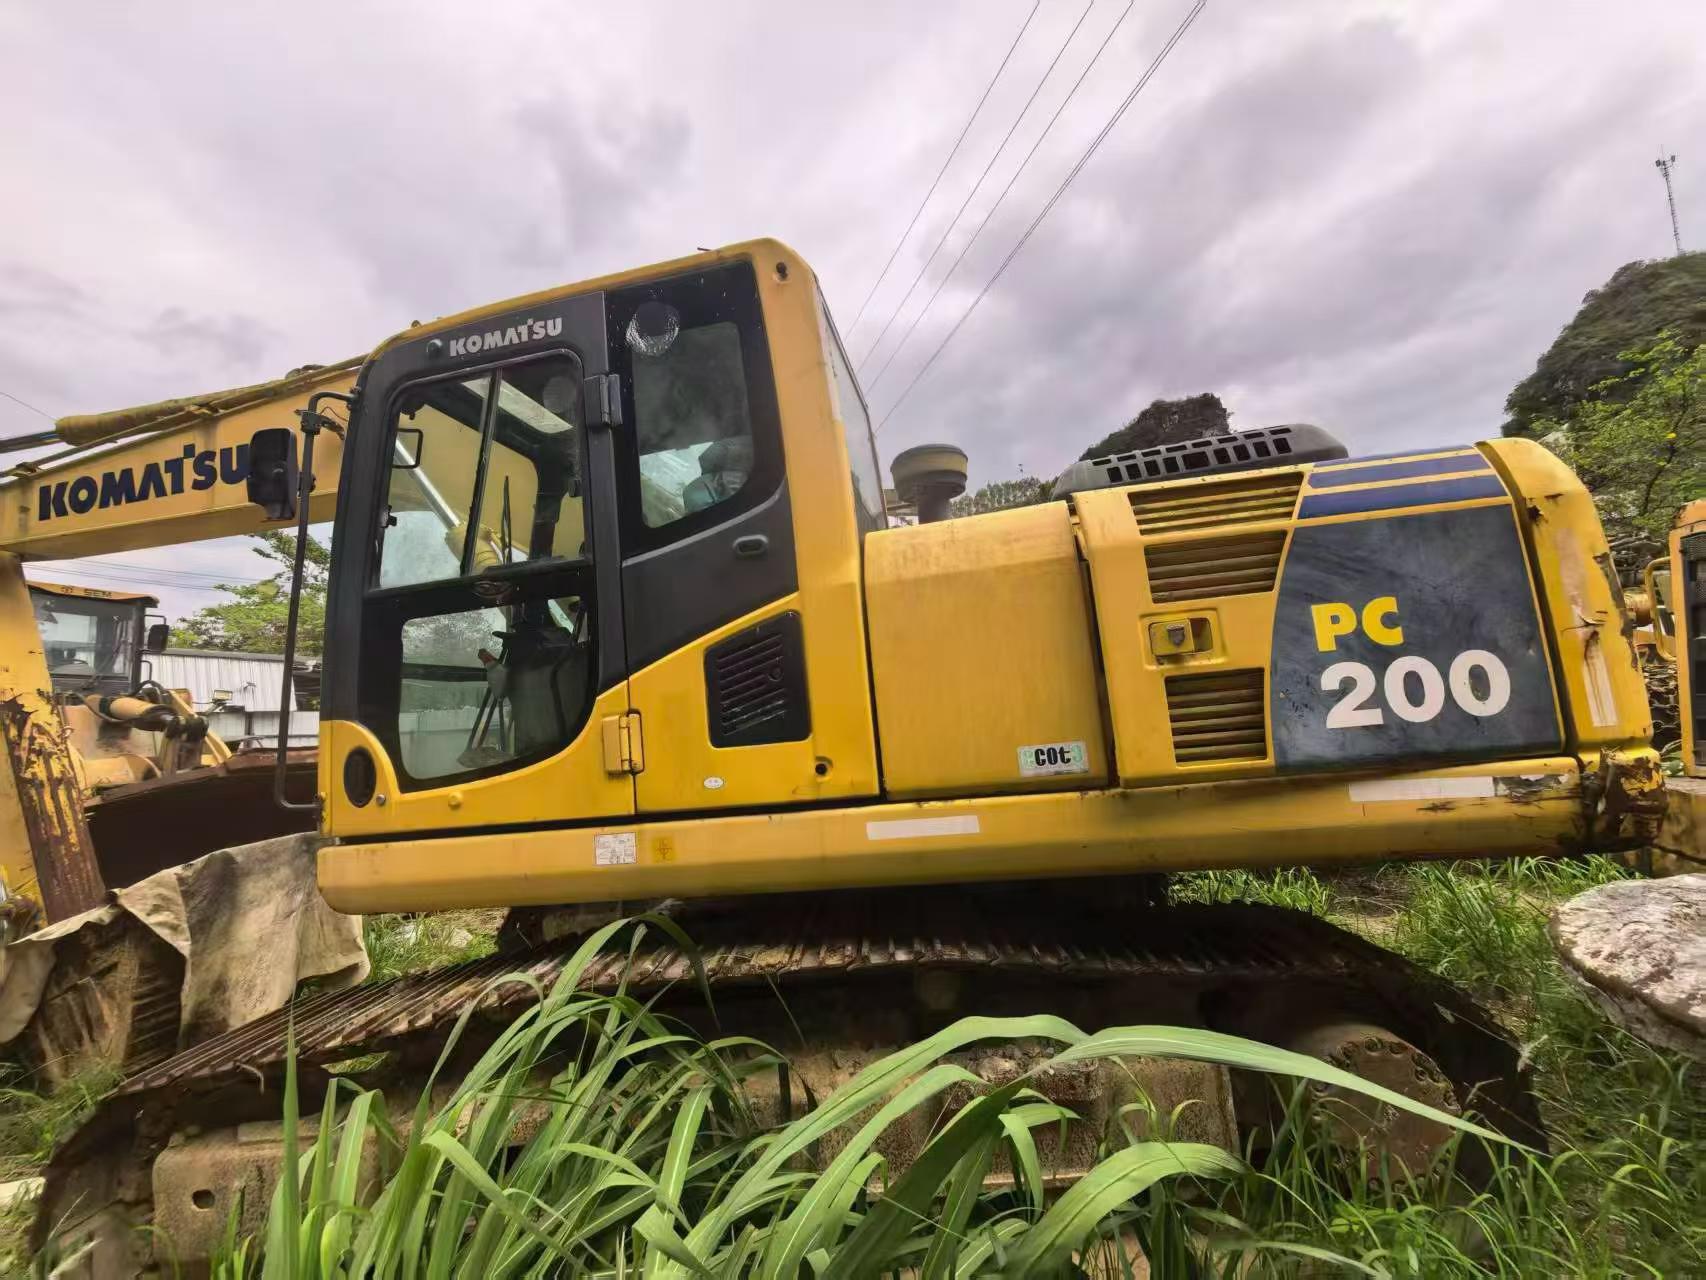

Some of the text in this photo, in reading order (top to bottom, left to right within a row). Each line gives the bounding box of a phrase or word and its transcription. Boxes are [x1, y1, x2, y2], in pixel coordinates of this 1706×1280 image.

[449, 317, 563, 357] KOMATSU
[38, 443, 250, 521] KOMATSU
[1311, 596, 1404, 652] PC
[1320, 649, 1511, 728] 200
